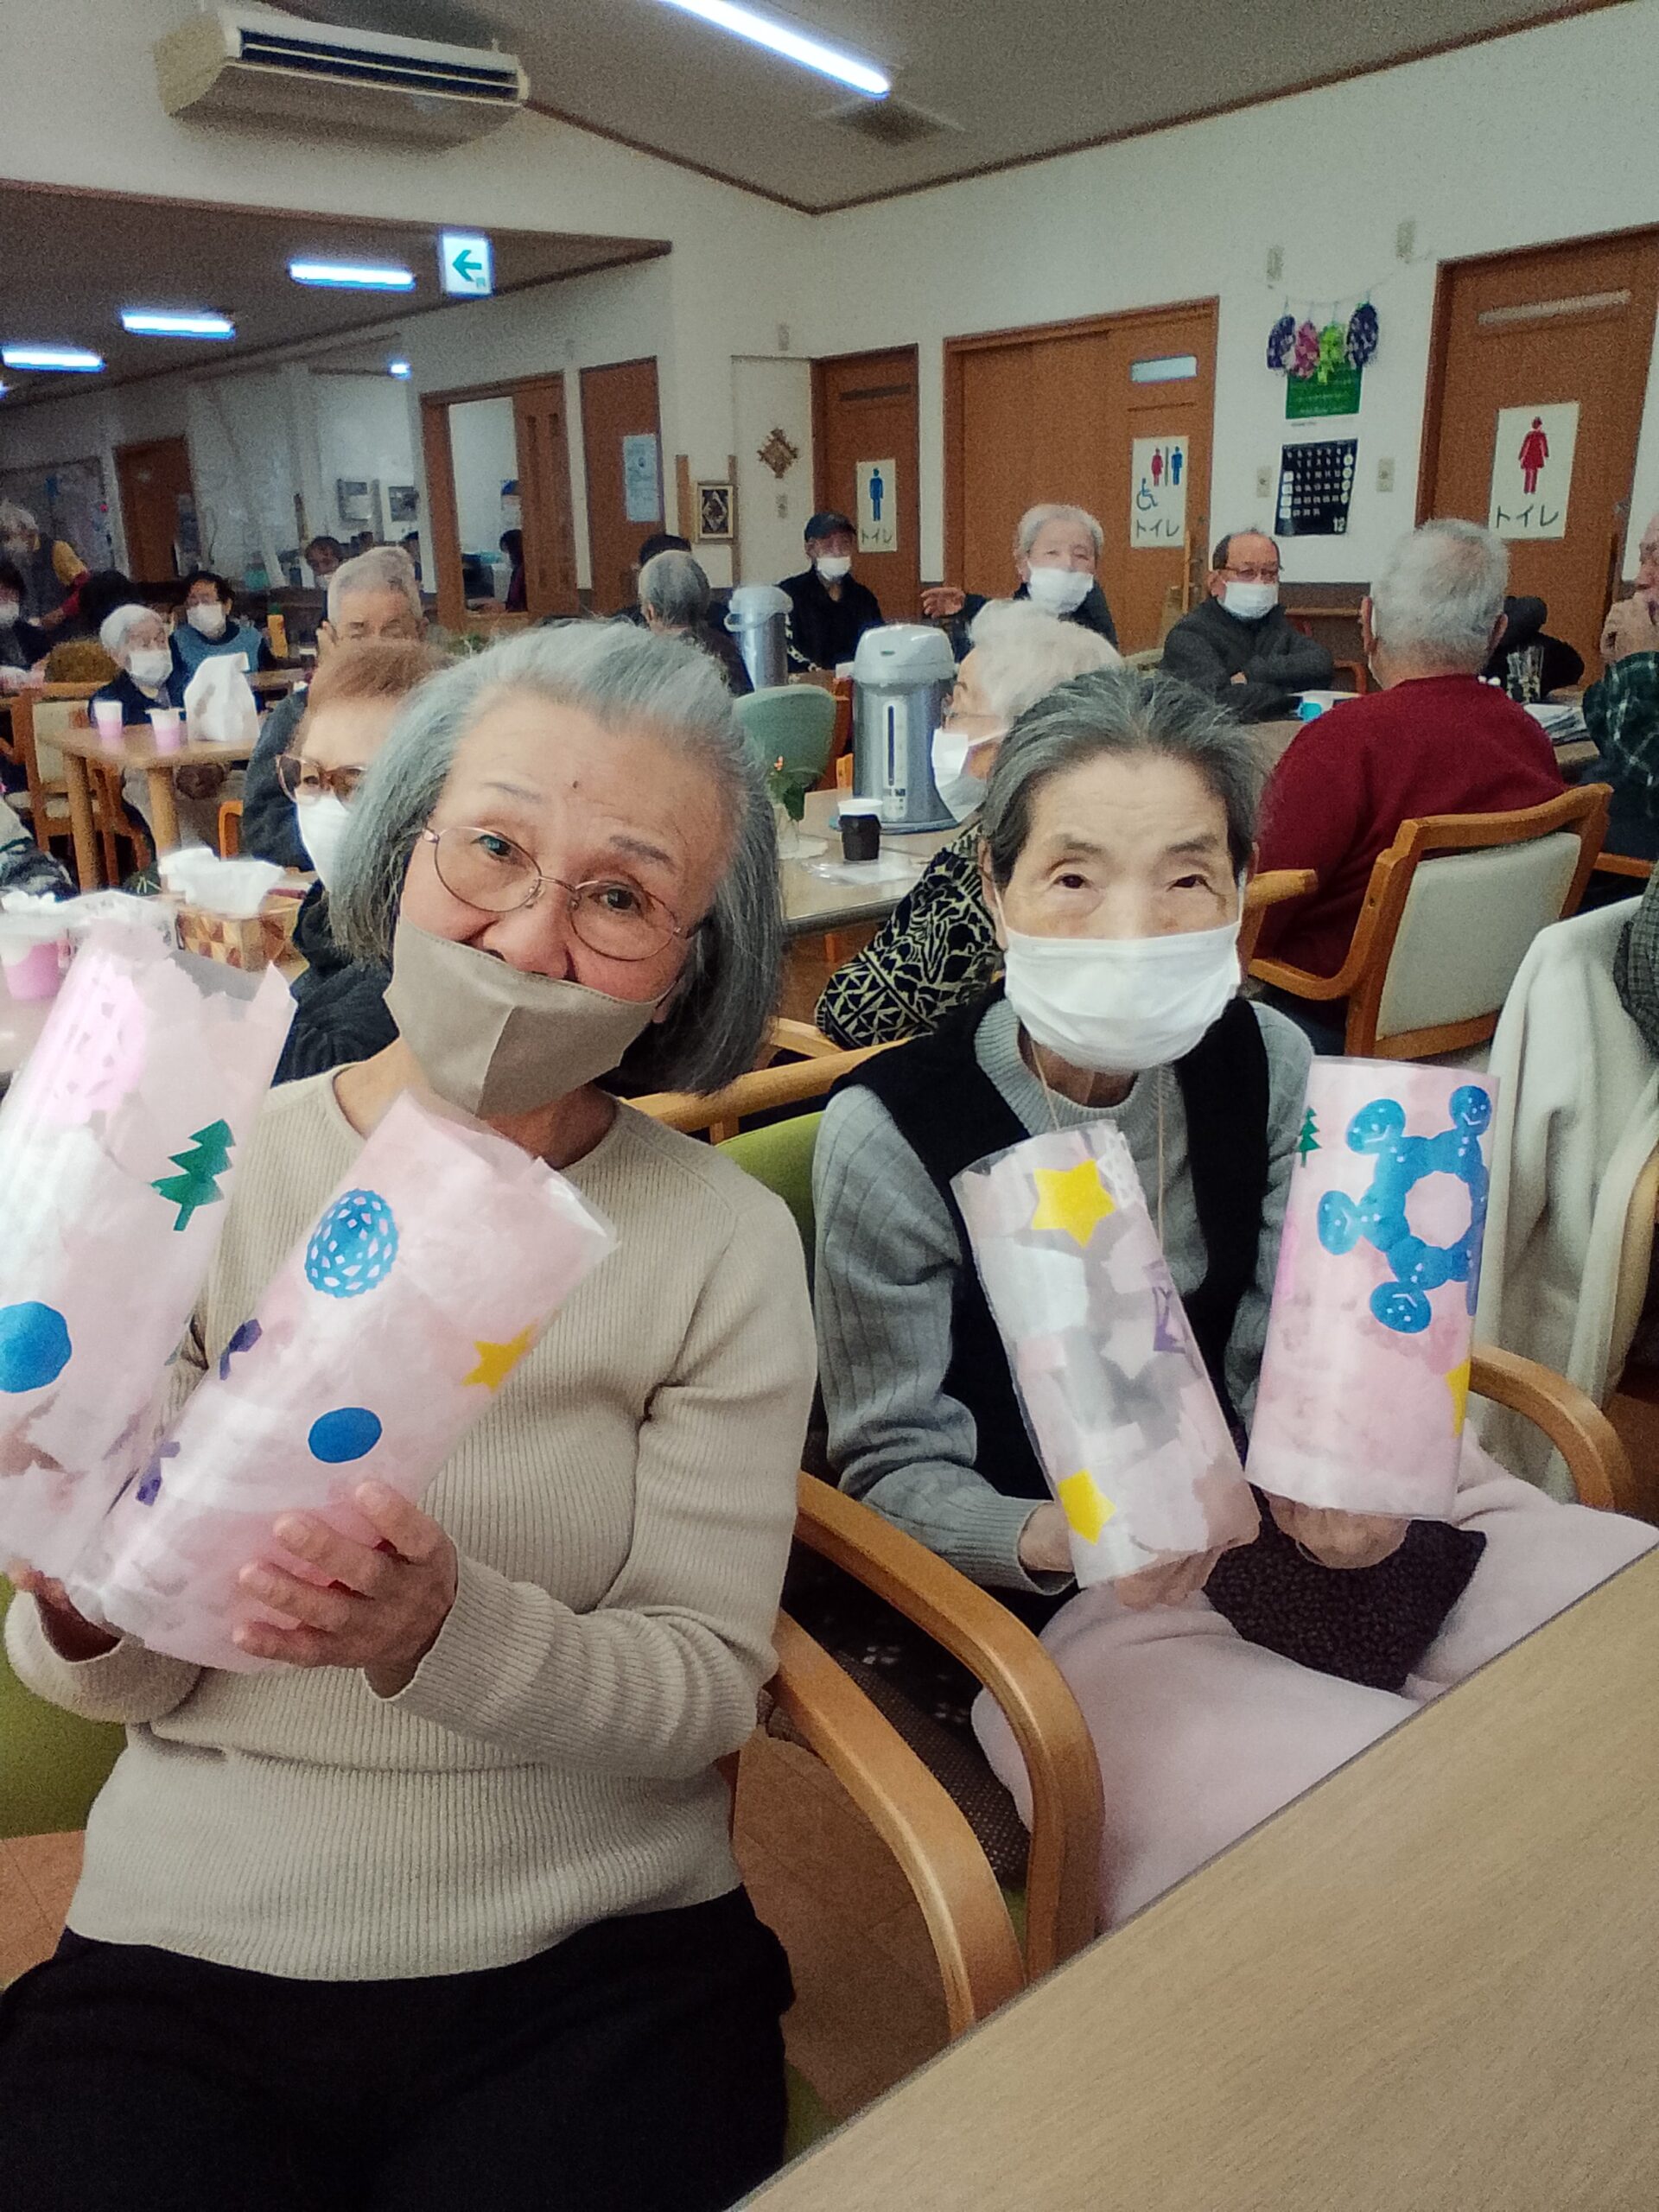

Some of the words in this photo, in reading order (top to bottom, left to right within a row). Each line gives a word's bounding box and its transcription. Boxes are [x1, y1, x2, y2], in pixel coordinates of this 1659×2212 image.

[1333, 518, 1345, 532] 12
[1497, 504, 1559, 529] トイレ
[861, 528, 893, 544] トイレ
[1136, 518, 1179, 539] トイレ
